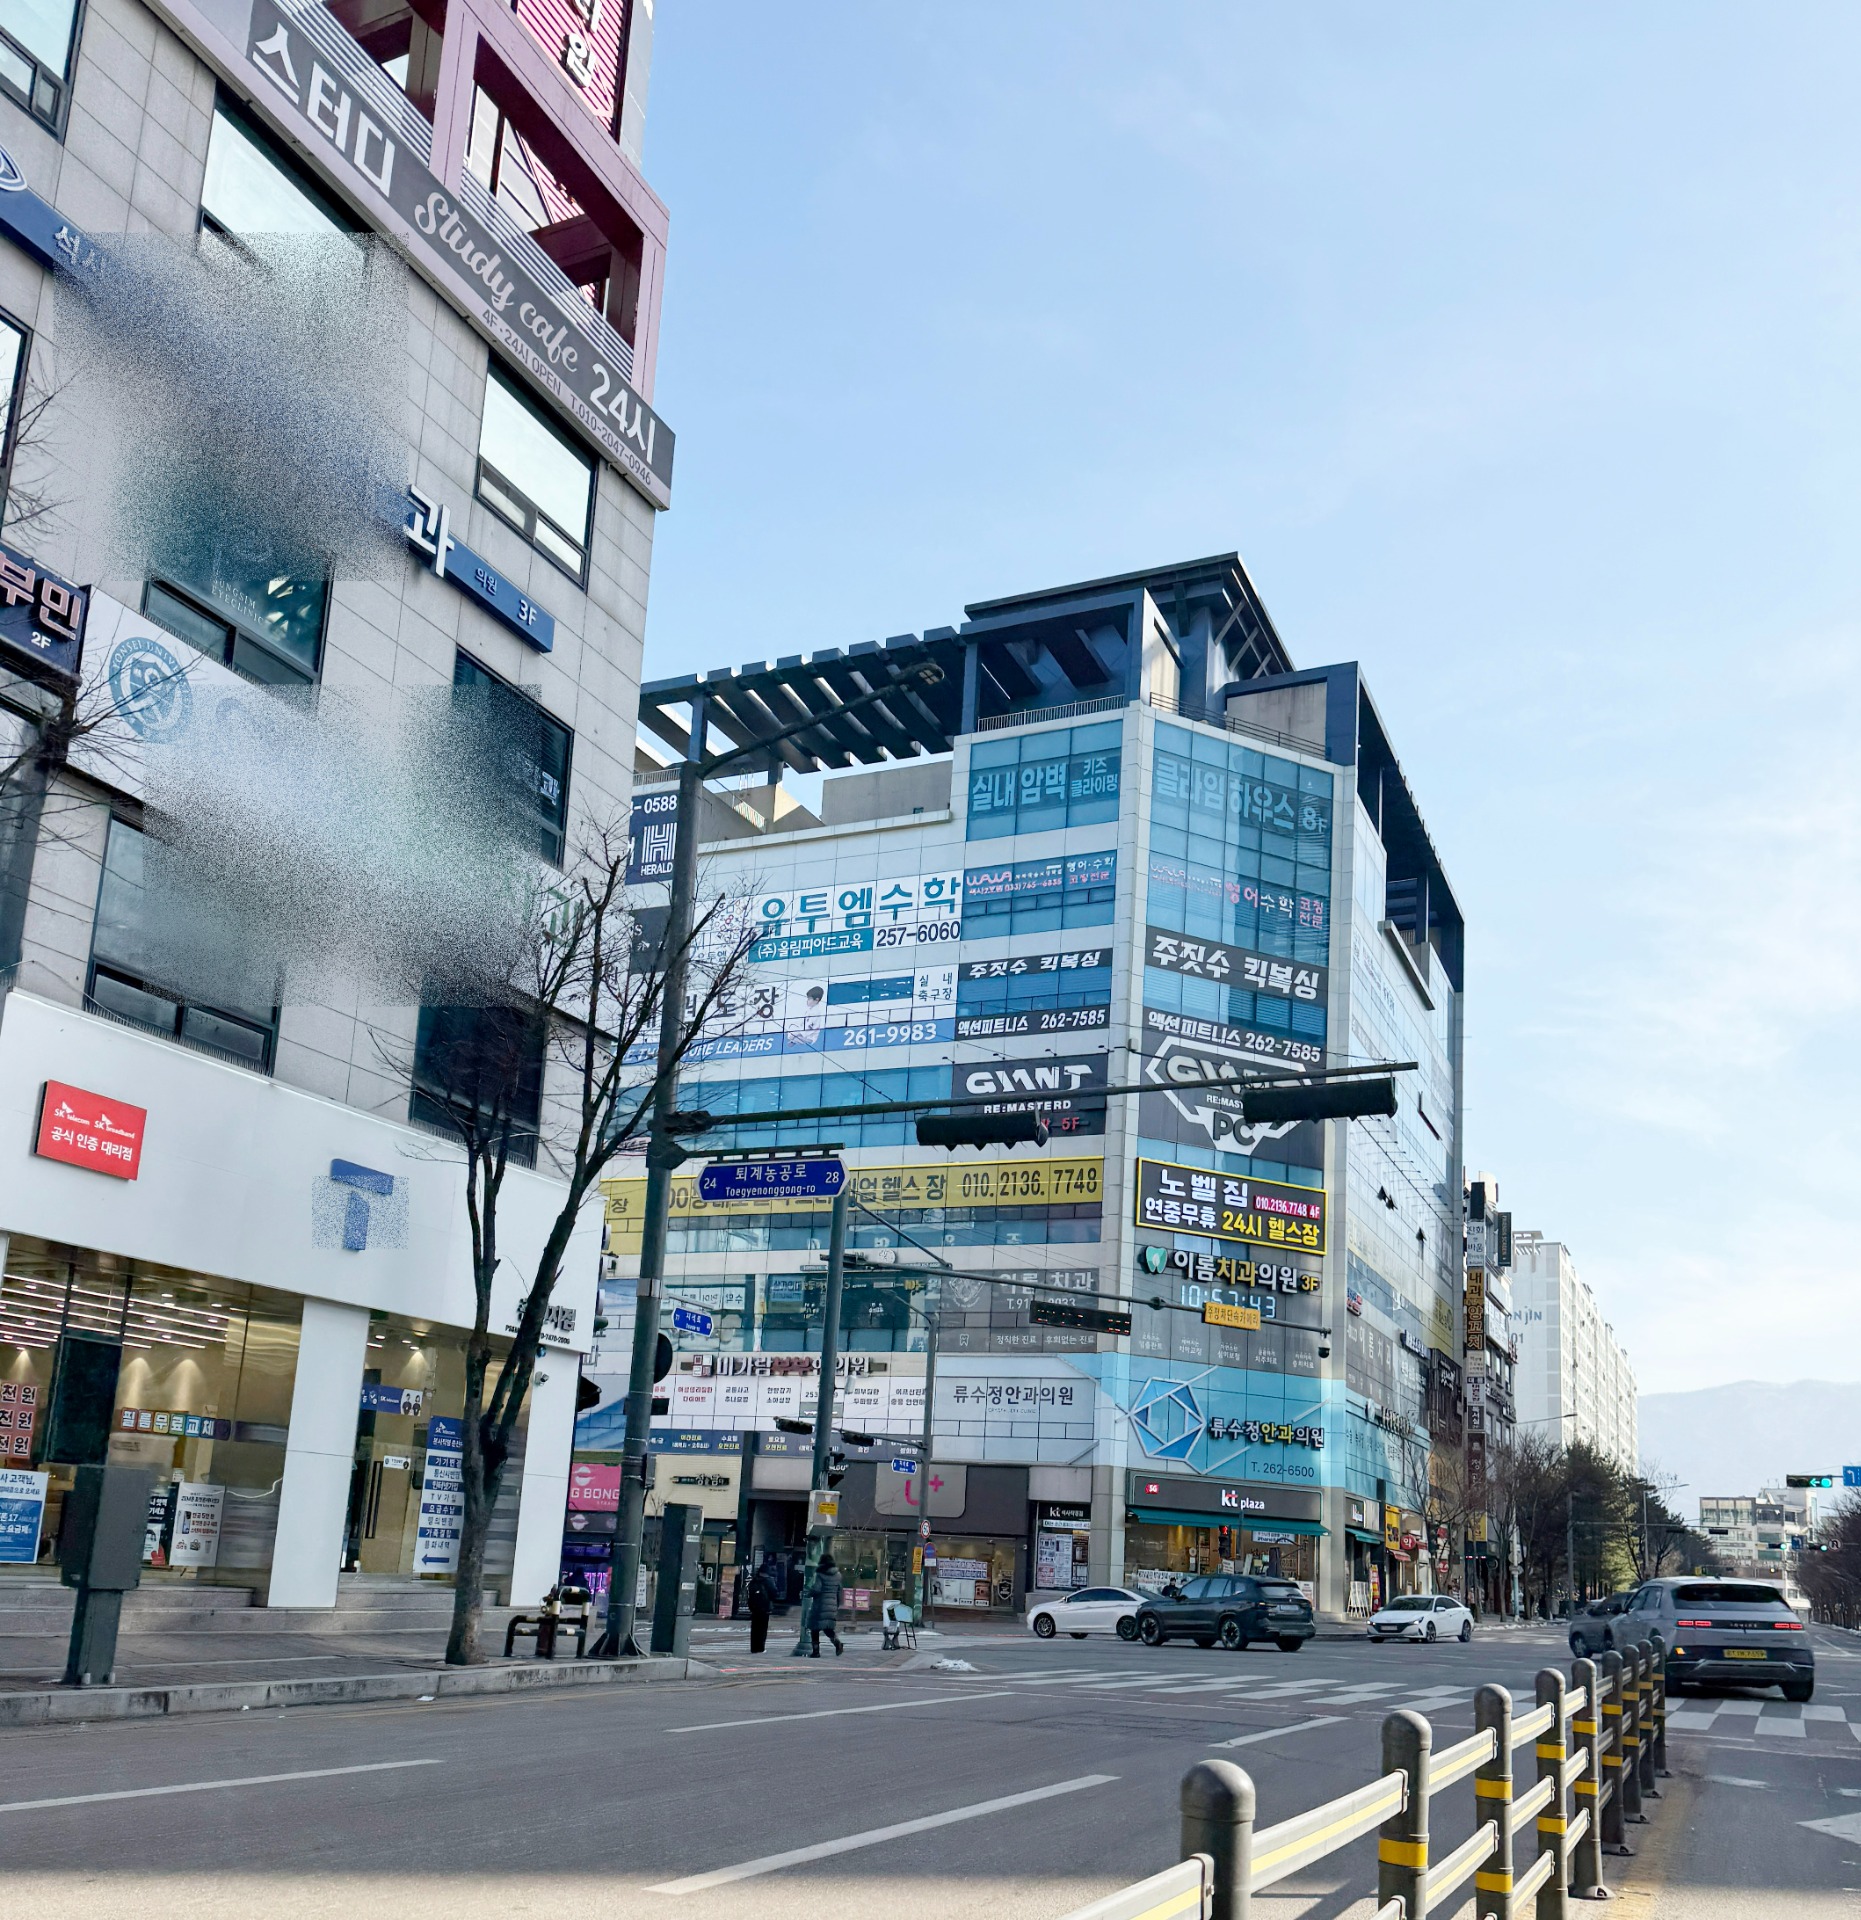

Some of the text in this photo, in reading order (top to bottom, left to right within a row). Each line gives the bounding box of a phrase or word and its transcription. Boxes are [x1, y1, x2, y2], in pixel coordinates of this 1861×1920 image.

[252, 22, 656, 465] 스터디 Study cafe 24시
[531, 354, 562, 397] OPEN
[474, 566, 499, 596] 의원
[518, 599, 538, 626] 3F
[31, 630, 52, 650] 2F
[1083, 757, 1107, 775] 키즈
[972, 763, 1067, 812] 실내 암벽
[1071, 774, 1118, 798] 클라이밍
[1156, 756, 1295, 830] 클라임하우스
[640, 863, 673, 876] HERALD
[755, 876, 961, 939] 유투엠수학
[758, 920, 962, 959] (주)올림피아드교육 257-6060
[969, 951, 1102, 979] 주짓수 킥복싱
[1152, 935, 1320, 1000] 주짓수 킥복싱
[919, 988, 952, 1002] 축구장
[717, 1037, 775, 1052] LEADERS
[843, 1022, 938, 1047] 261-9983
[957, 1009, 1106, 1037] 액션피트니스 262-7585
[1148, 1010, 1321, 1063] 액션피트니스 262-7585
[965, 1064, 1093, 1094] GIANT
[54, 1108, 65, 1118] SK
[94, 1120, 105, 1130] SK
[983, 1099, 1072, 1114] RE:MASTERD
[51, 1126, 133, 1162] 공식 인증 대리점
[703, 1177, 718, 1190] 24
[735, 1163, 807, 1182] 퇴계농공로
[825, 1171, 840, 1184] 28
[725, 1184, 816, 1198] Toegyenonggong-ro
[1159, 1169, 1321, 1219] 노벨짐 010.2136.7748 4F
[1145, 1197, 1320, 1247] 연중무휴 24시 헬스장
[1052, 1271, 1095, 1292] 치과
[1173, 1250, 1320, 1294] 이롬치과의원 3F
[953, 1385, 1074, 1406] 류수정안과의원
[1210, 1417, 1325, 1448] 류수정안과의원
[1262, 1463, 1315, 1478] 262-6500
[1221, 1489, 1265, 1510] kt plaza
